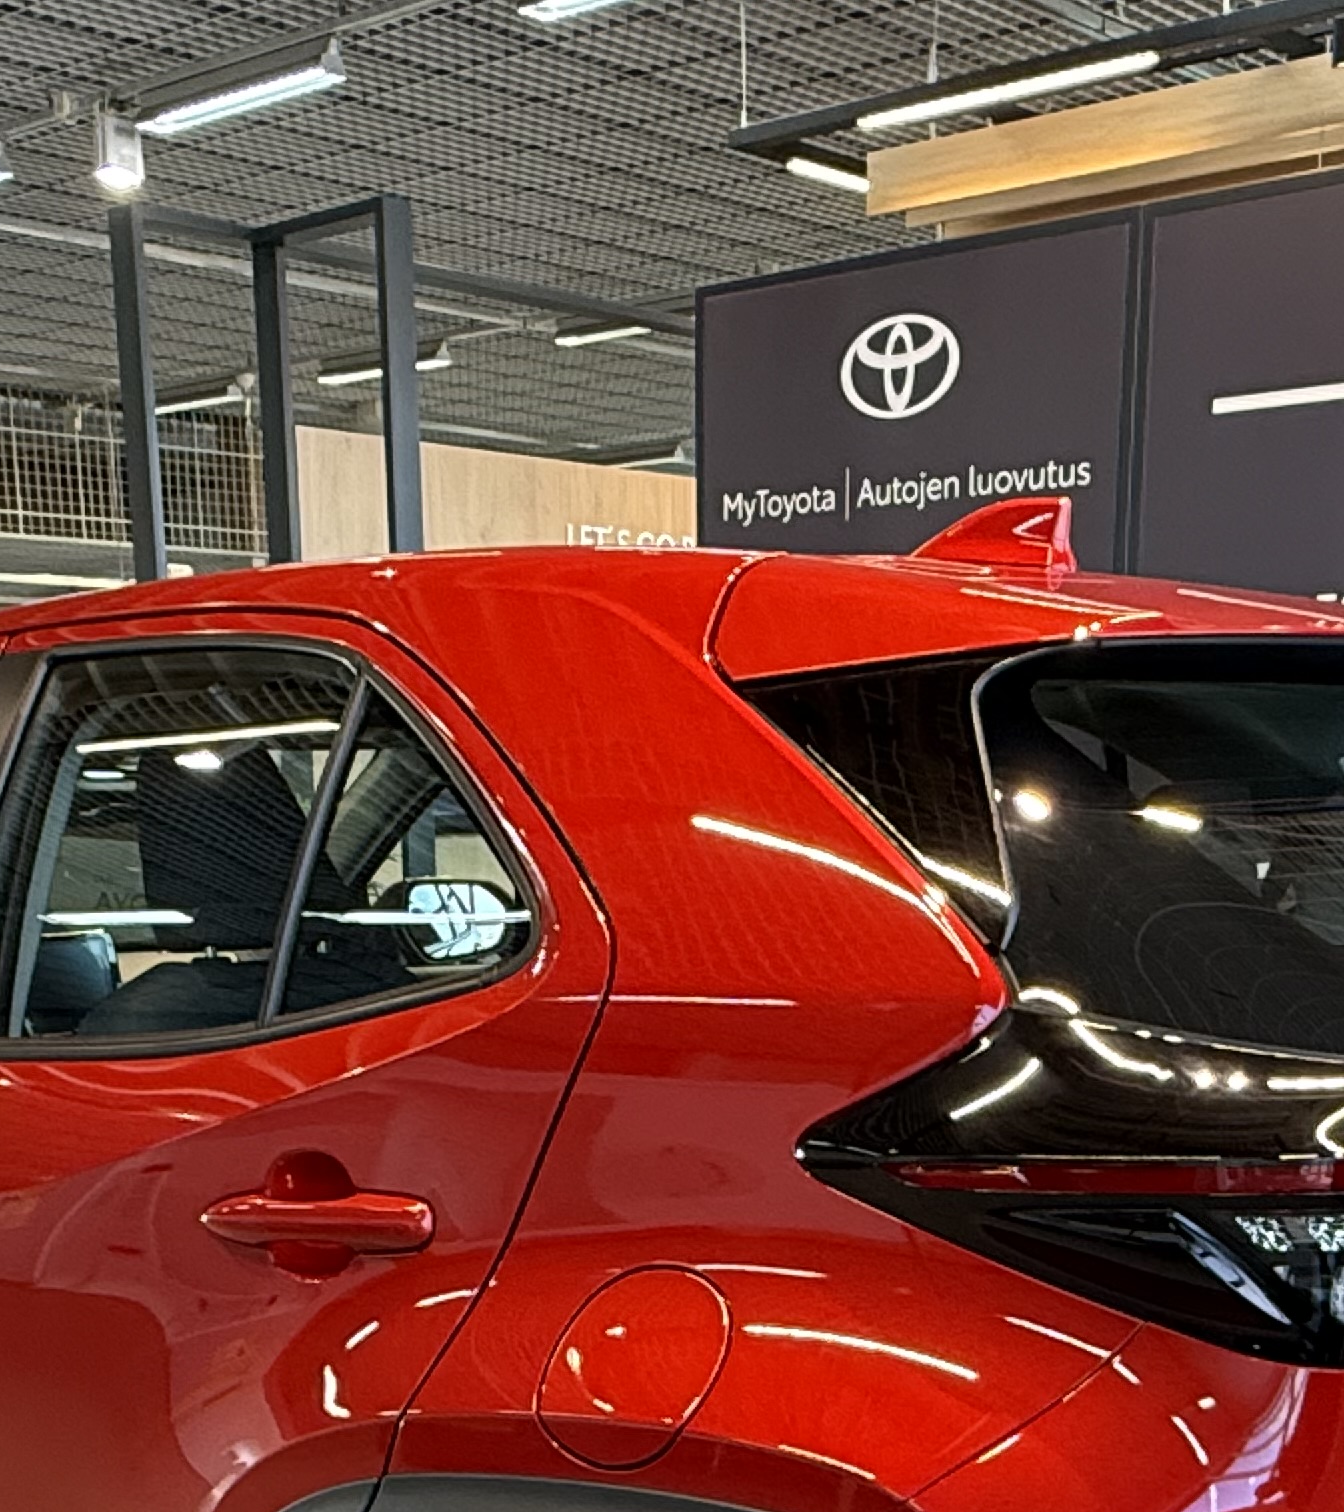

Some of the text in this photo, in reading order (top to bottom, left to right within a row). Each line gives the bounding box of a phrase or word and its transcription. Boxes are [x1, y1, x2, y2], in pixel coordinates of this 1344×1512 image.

[722, 460, 1092, 527] MyToyota Autojen luovutus
